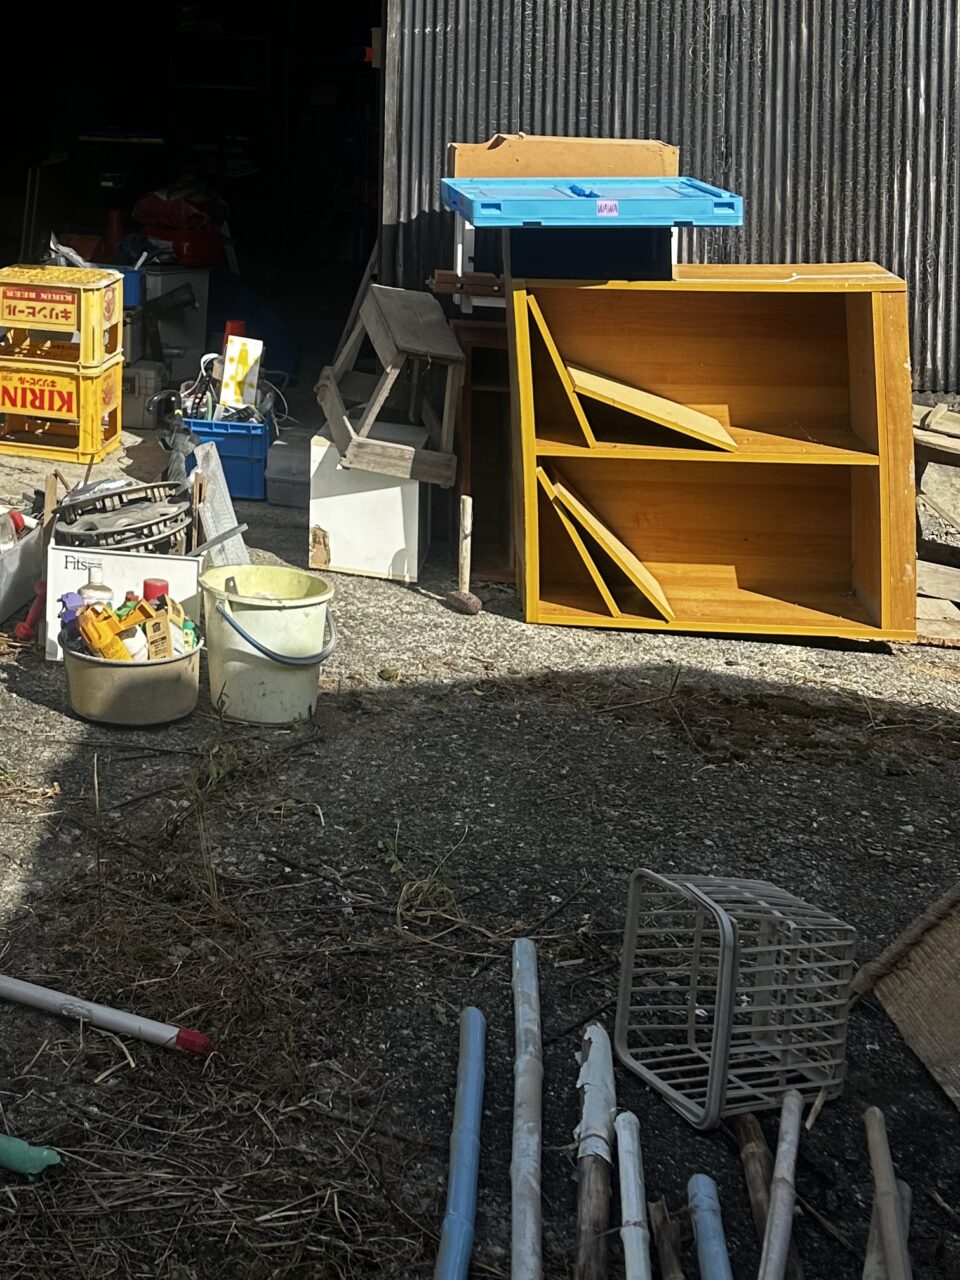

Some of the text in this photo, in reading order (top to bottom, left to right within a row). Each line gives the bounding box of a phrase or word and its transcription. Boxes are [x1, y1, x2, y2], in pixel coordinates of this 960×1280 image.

[6, 290, 73, 301] KIRIN BEER
[5, 304, 72, 320] キリンビール
[18, 376, 57, 388] キリンビール
[1, 384, 74, 413] KIRIN
[64, 555, 88, 570] Fits
